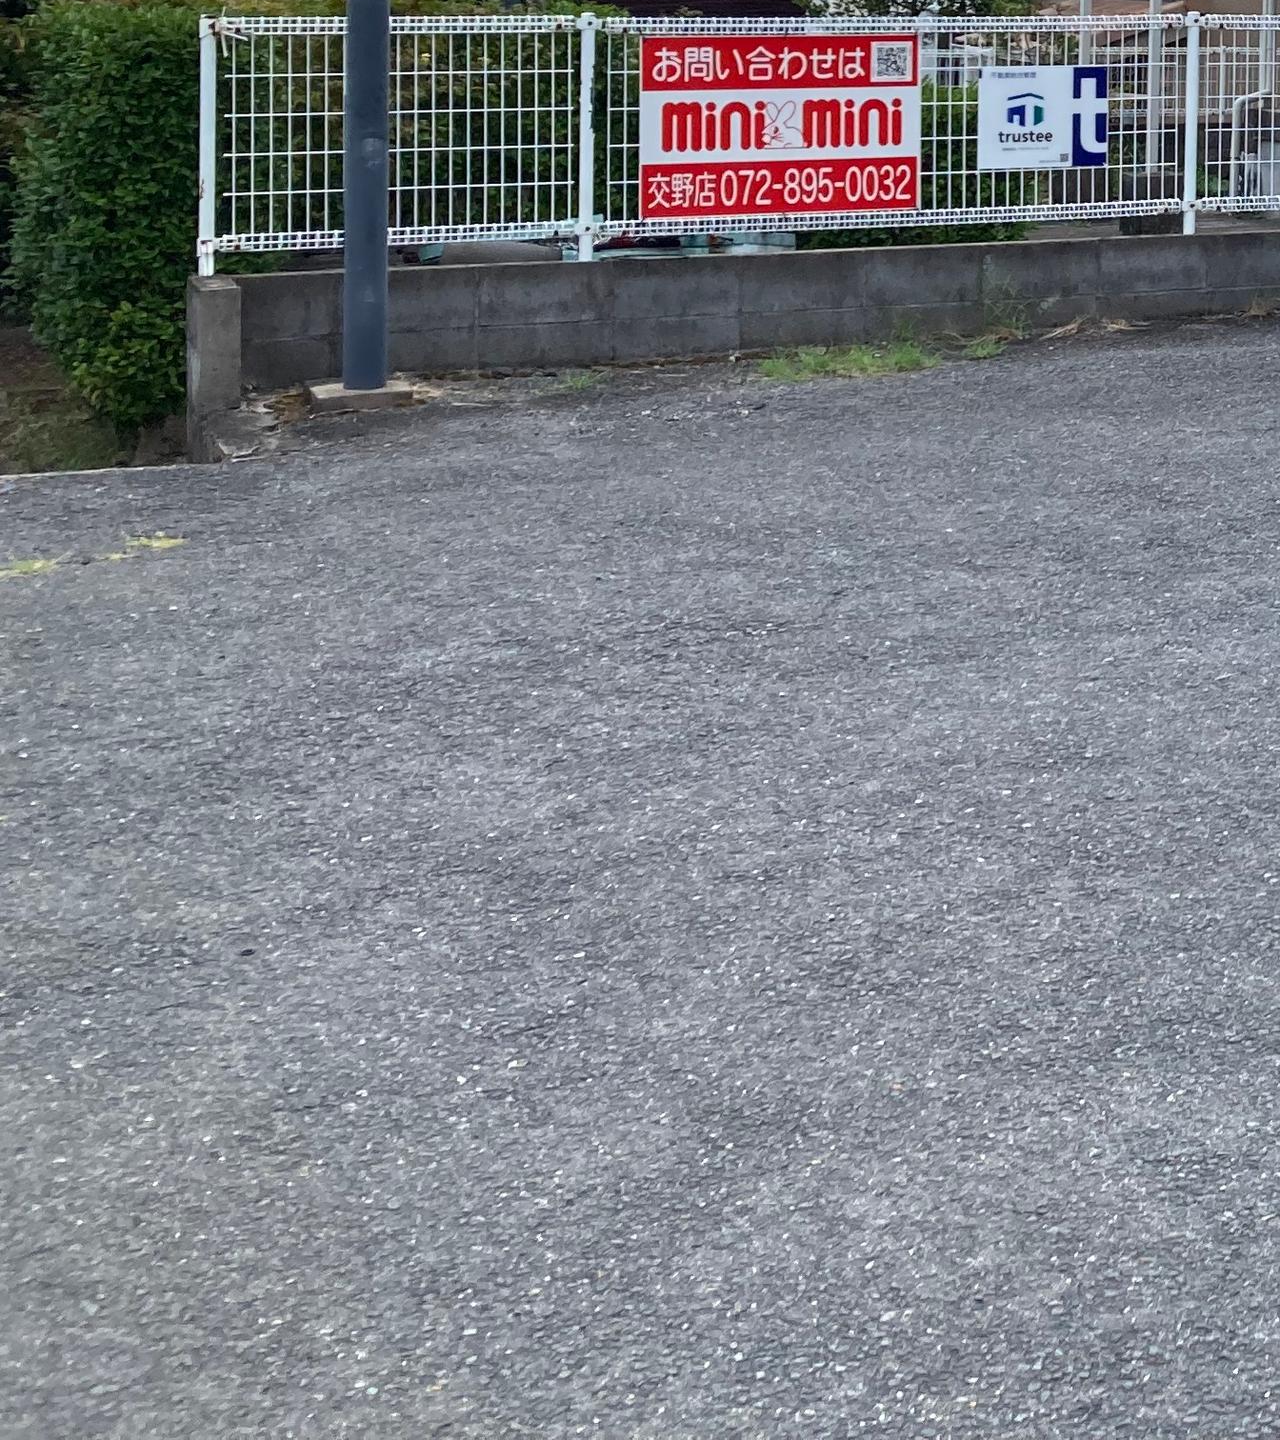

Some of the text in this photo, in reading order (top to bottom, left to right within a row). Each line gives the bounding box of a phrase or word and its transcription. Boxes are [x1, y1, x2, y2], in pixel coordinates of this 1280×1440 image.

[652, 46, 865, 82] お問い合わせは
[662, 98, 902, 152] mini mini
[998, 131, 1053, 143] trustee
[648, 165, 911, 209] 交野店 072-895-0032
